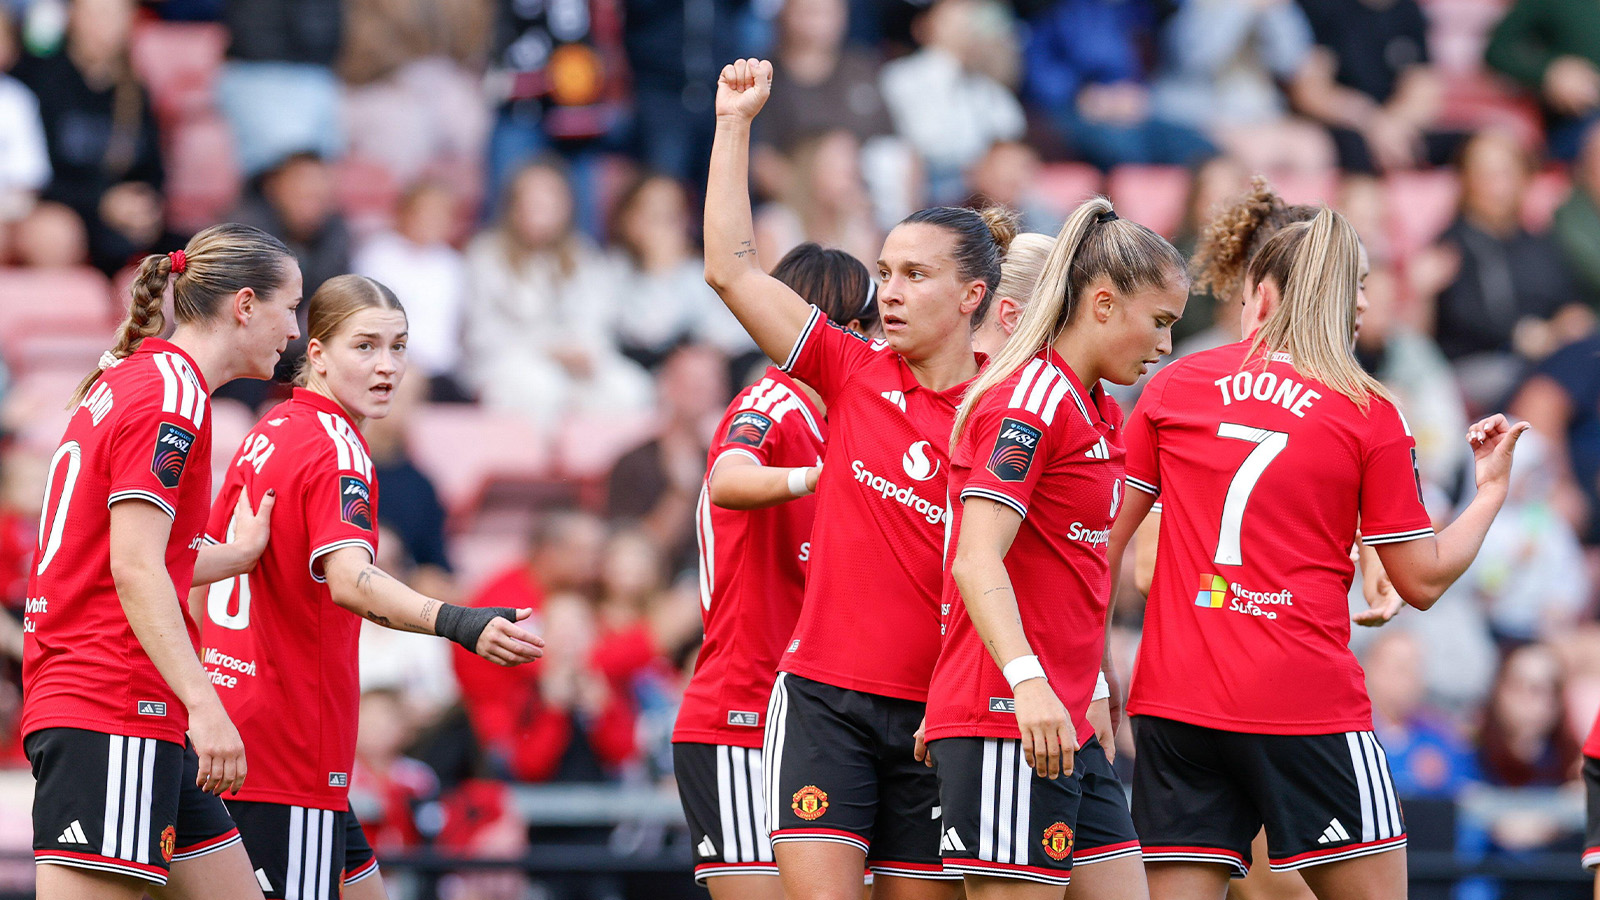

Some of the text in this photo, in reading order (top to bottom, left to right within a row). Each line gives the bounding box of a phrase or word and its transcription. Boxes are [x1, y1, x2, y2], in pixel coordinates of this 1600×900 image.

[1214, 371, 1322, 418] TOONE
[160, 433, 191, 453] WSL
[1000, 428, 1036, 449] WSL
[1213, 421, 1289, 566] 7
[204, 647, 257, 677] Microsoft
